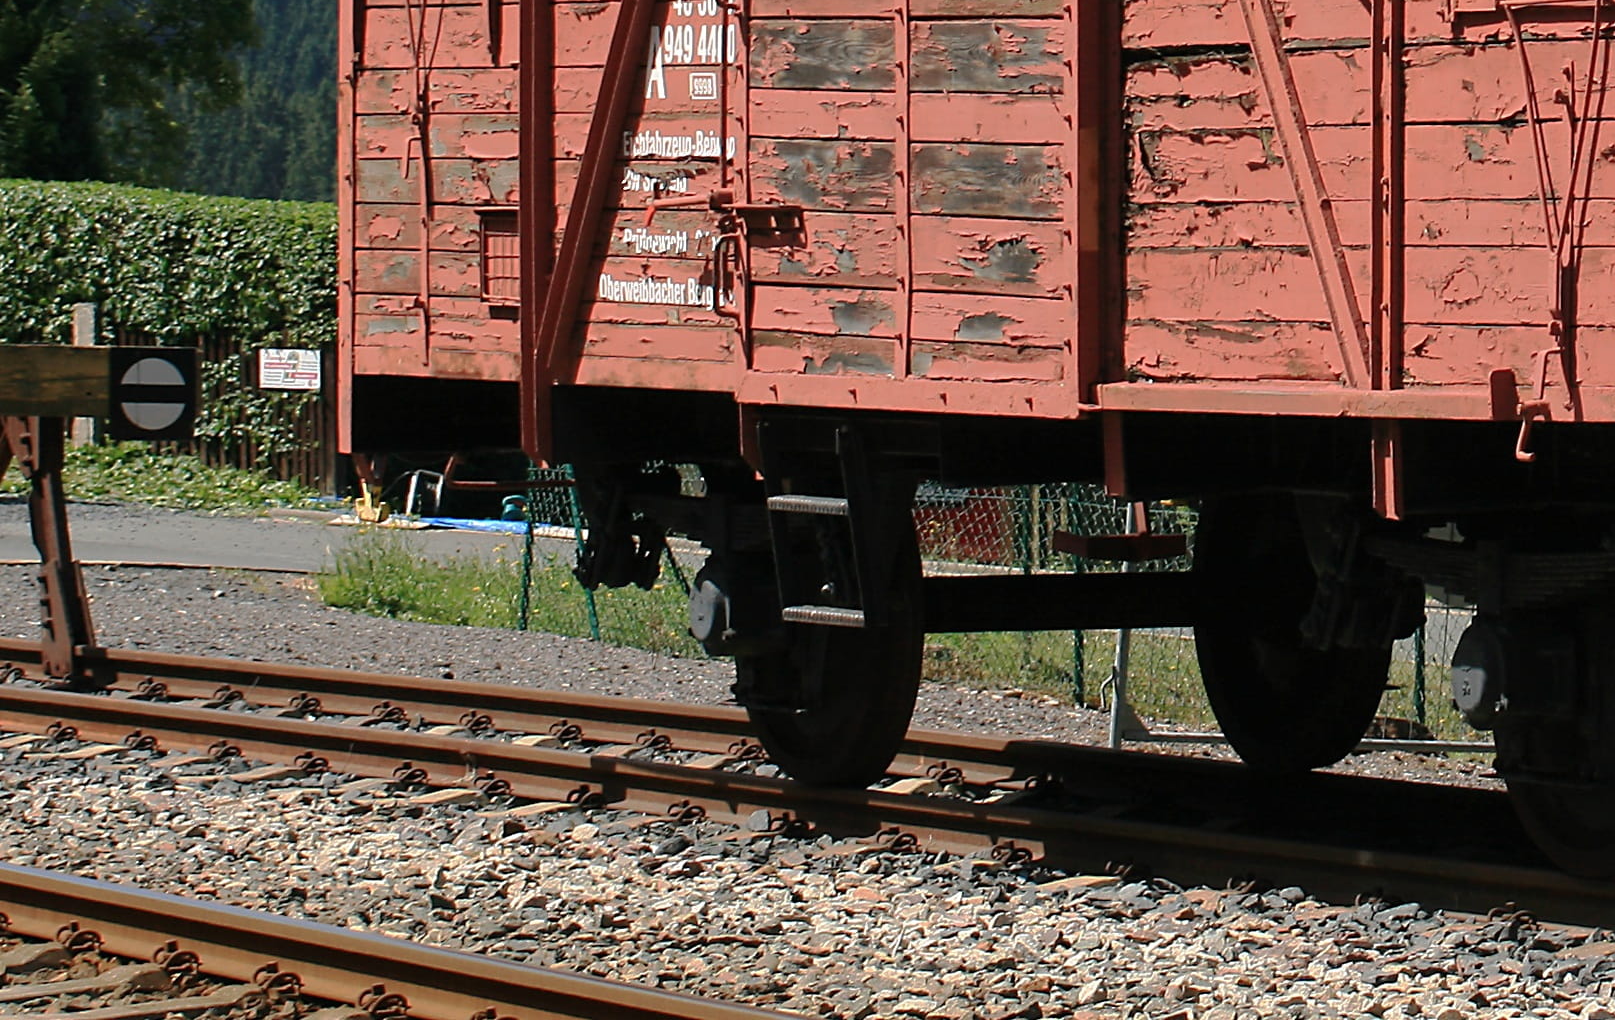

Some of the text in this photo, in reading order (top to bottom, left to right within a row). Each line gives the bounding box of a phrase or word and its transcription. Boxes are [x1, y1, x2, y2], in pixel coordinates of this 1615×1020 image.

[645, 26, 666, 98] A
[664, 24, 694, 64] 949
[599, 274, 686, 305] Oberweißbacher
